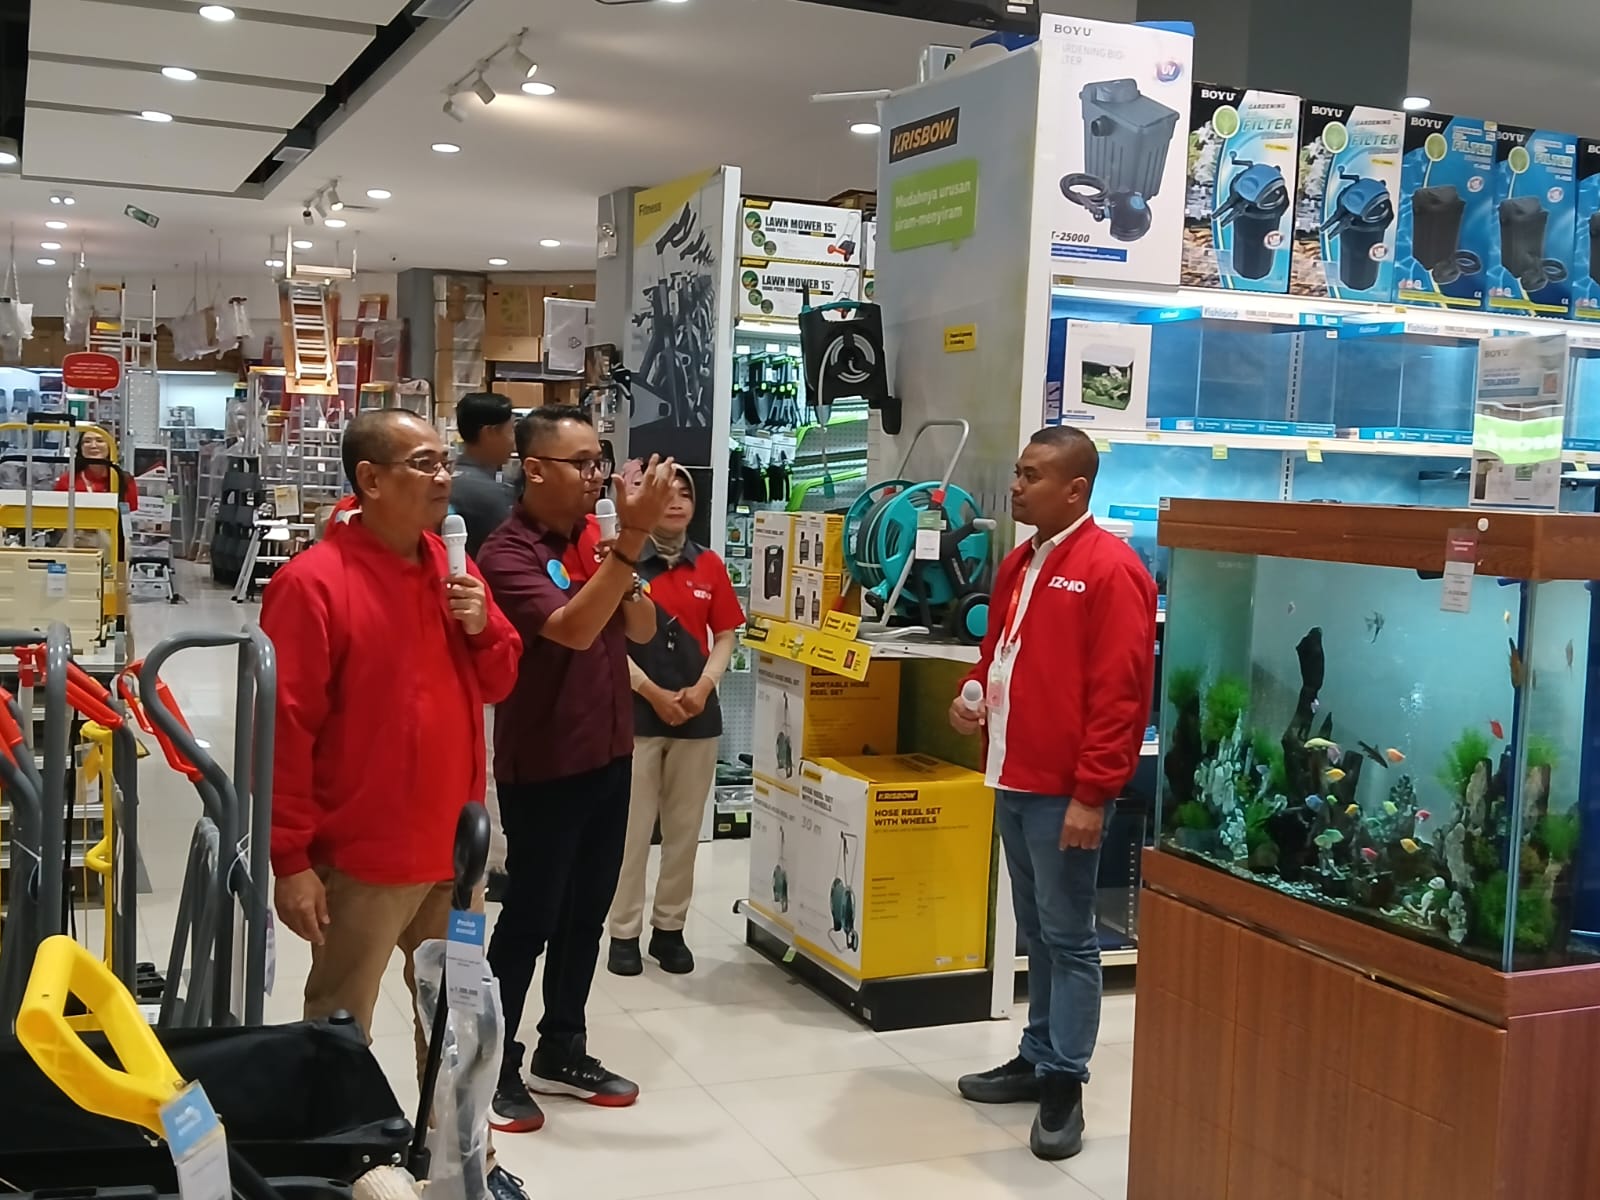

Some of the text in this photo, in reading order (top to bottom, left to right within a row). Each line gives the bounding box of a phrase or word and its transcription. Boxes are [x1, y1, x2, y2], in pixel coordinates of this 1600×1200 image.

[1054, 24, 1092, 37] BOYU
[1201, 89, 1237, 101] BOYU
[1311, 105, 1344, 118] BOYU
[1243, 118, 1293, 130] FILTER
[1410, 117, 1443, 129] BOYU
[892, 117, 955, 155] KRISBOW
[1351, 134, 1399, 146] FILTER
[895, 180, 971, 209] Mudahnya urusan
[638, 202, 662, 217] Fitness
[765, 216, 789, 228] LAWN
[790, 218, 822, 232] MOWER
[762, 275, 786, 287] LAWN
[787, 277, 819, 290] MOWER
[810, 681, 870, 689] PORTABLE HOSE
[874, 807, 942, 817] HOSE REEL SET
[874, 816, 937, 826] WITH WHEELS
